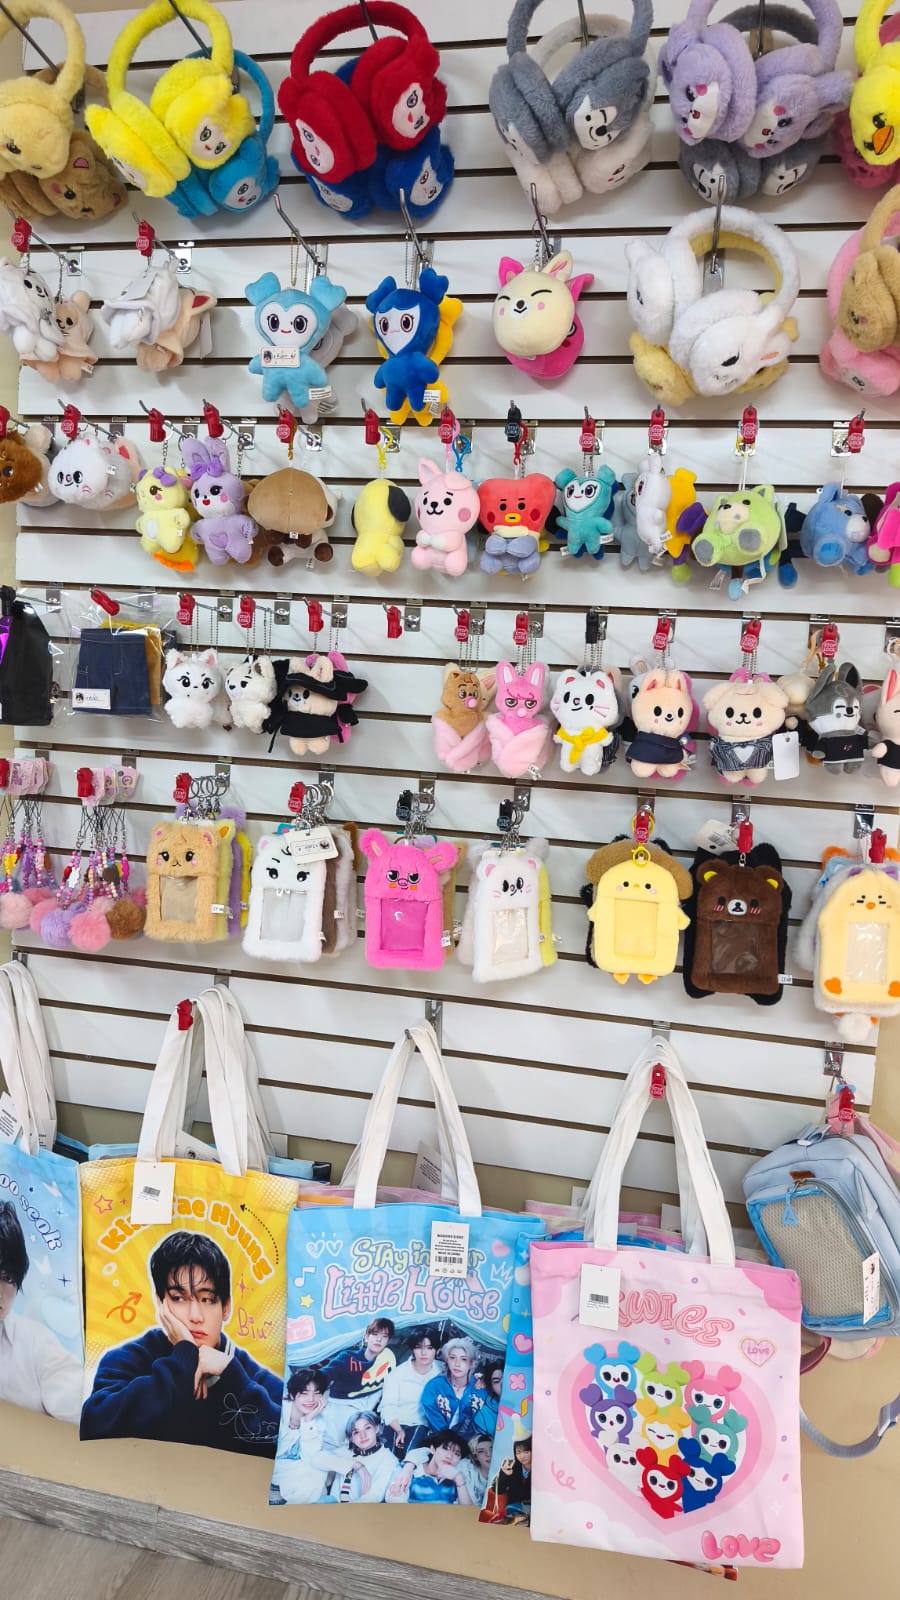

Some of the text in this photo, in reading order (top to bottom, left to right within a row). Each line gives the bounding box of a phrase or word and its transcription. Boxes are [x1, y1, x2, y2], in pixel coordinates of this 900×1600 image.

[172, 1195, 208, 1219] ae
[209, 1202, 275, 1283] Hyung
[323, 1265, 501, 1321] Little House
